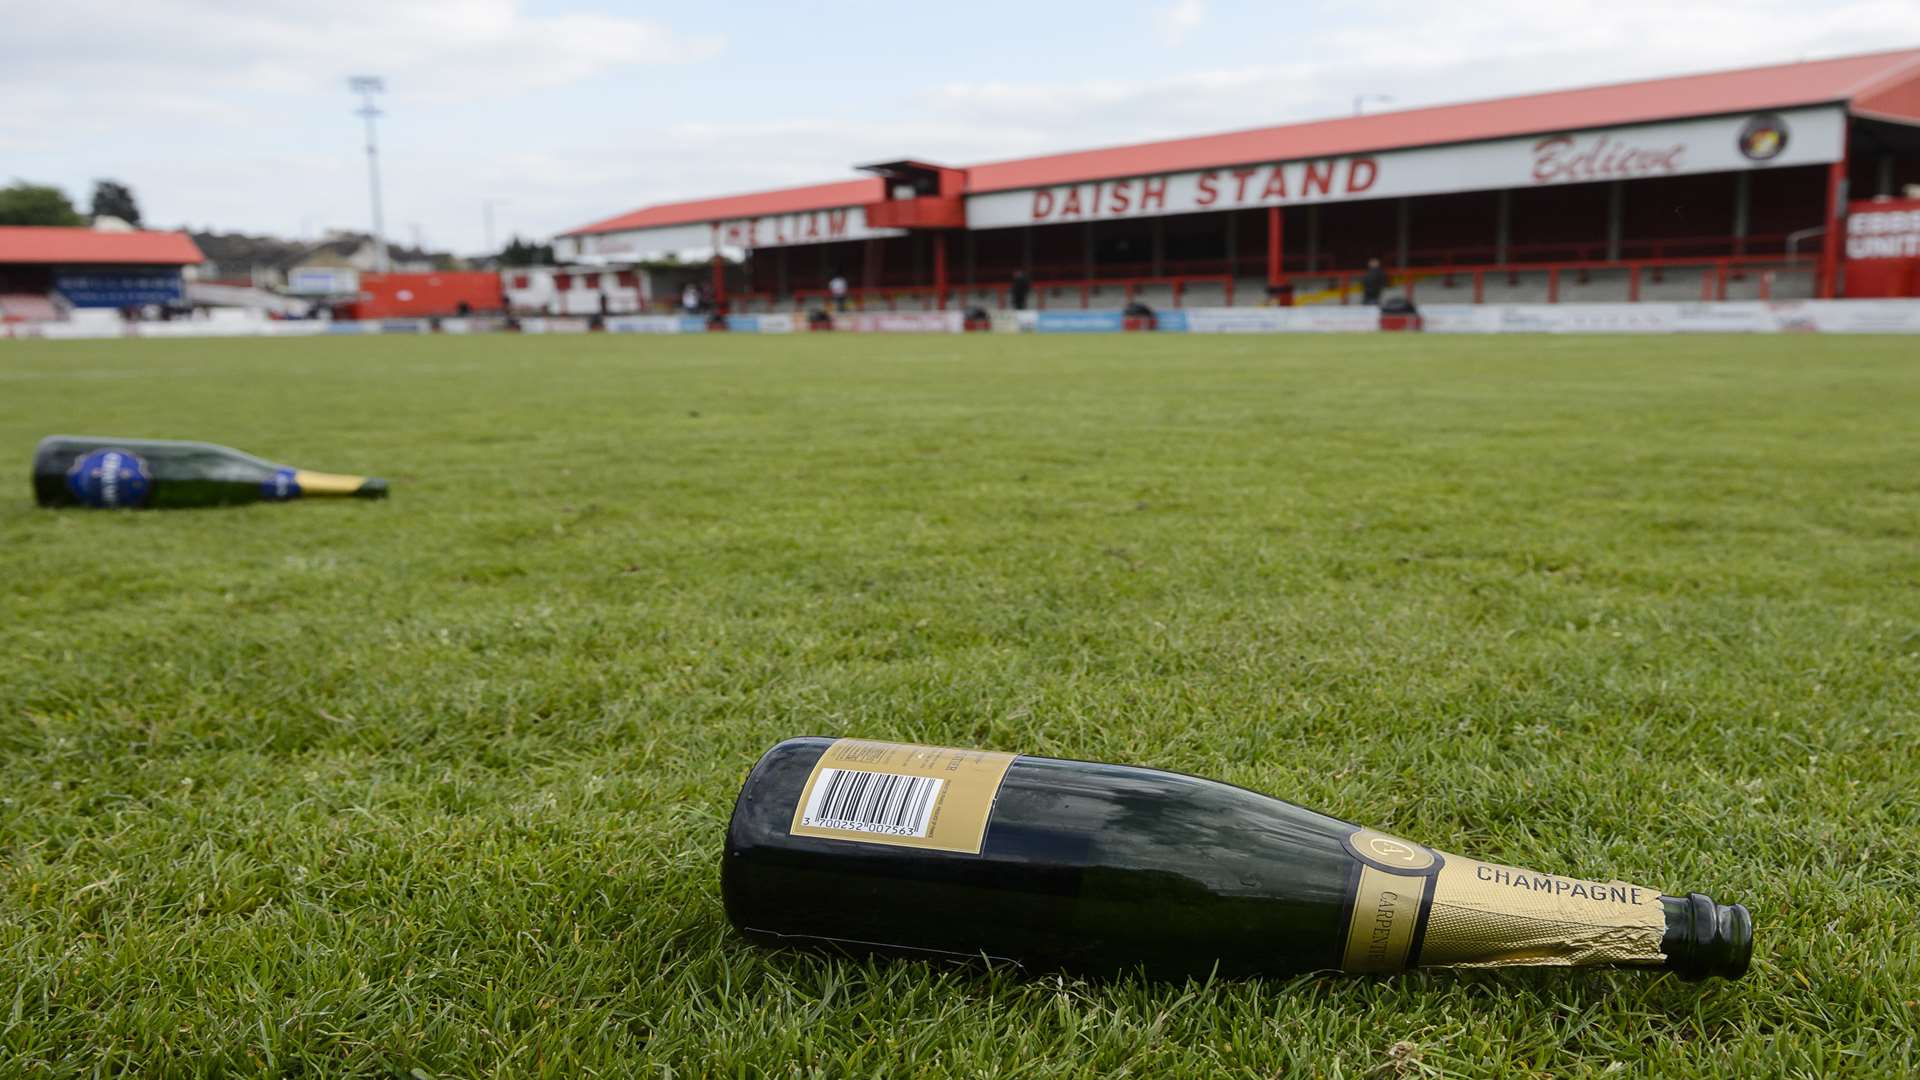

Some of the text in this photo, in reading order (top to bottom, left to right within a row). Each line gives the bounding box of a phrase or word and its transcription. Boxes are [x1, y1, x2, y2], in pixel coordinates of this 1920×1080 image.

[1531, 135, 1687, 182] Believe
[1032, 176, 1167, 219] DAISH
[1195, 157, 1378, 205] STAND
[803, 817, 914, 837] 3 700252 007563
[1476, 865, 1644, 906] CHAMPAGNE
